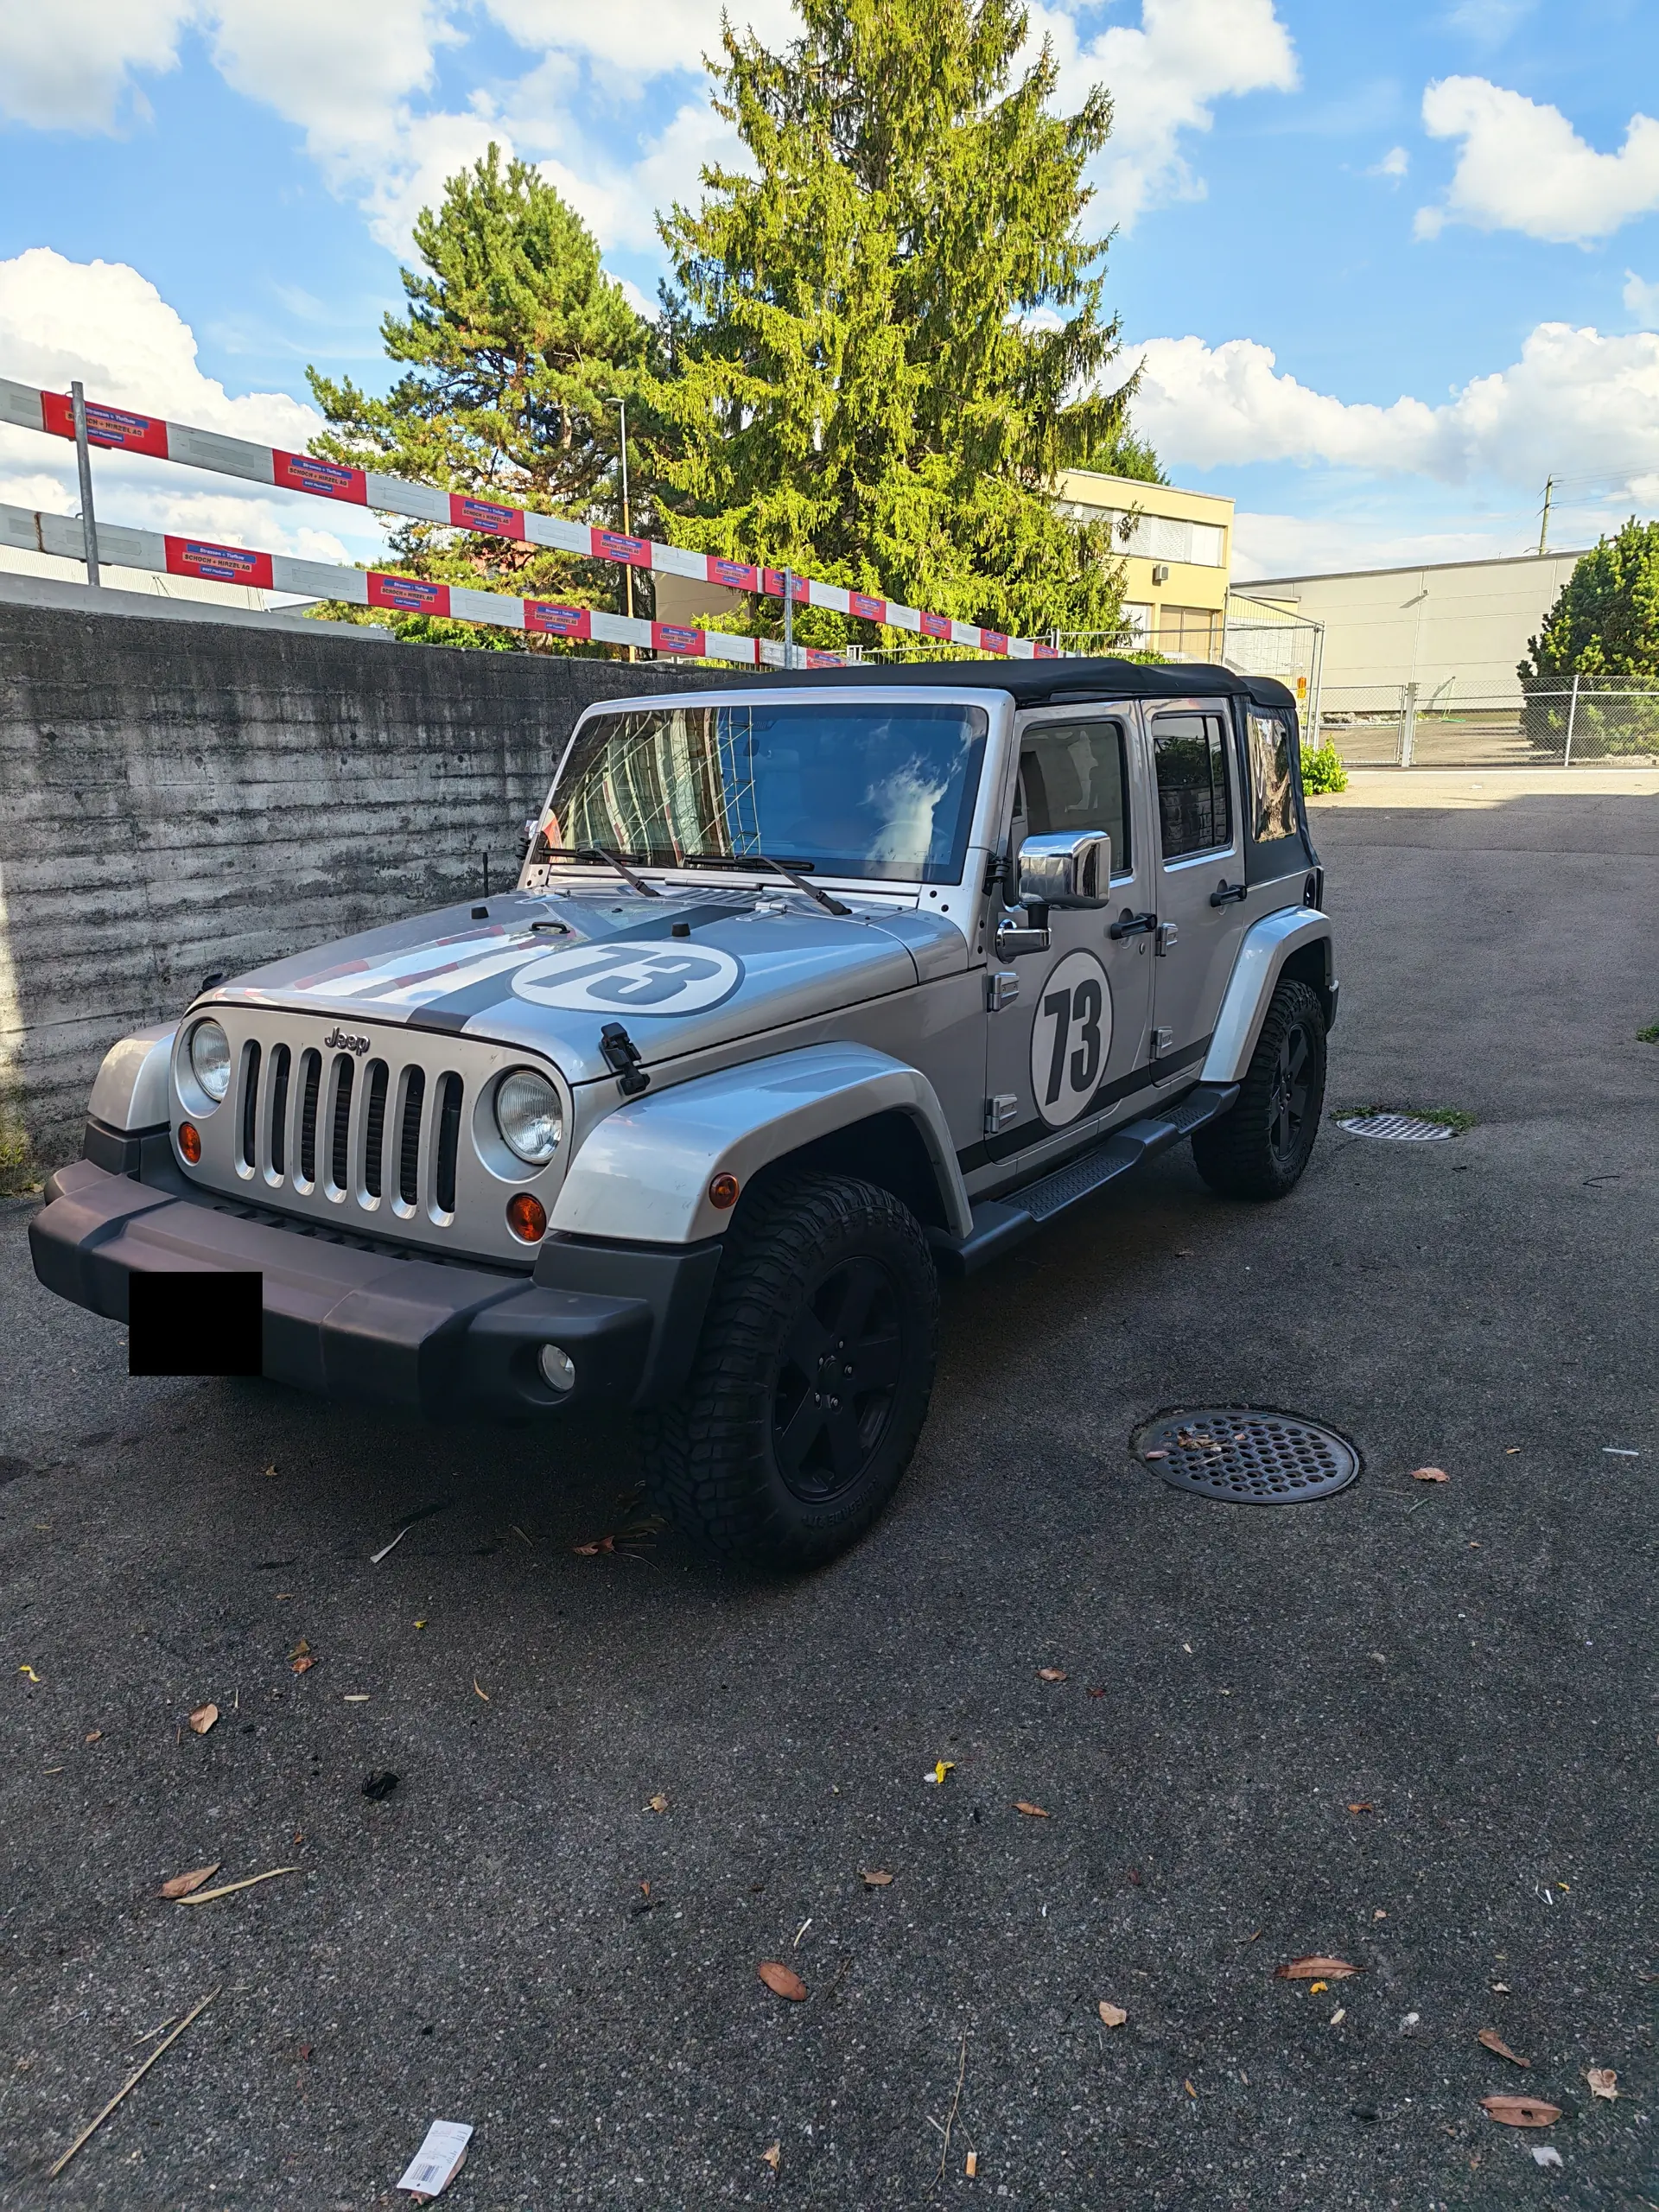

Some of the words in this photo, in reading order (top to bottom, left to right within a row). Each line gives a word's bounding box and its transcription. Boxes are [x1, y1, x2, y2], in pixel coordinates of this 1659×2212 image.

[67, 413, 98, 425] SCH
[105, 423, 130, 434] HIRZEL
[289, 467, 313, 477] SCHOCH
[319, 475, 338, 484] HIRZEL
[184, 554, 211, 563] SCHOCH
[218, 560, 240, 569] HIRZEL
[523, 946, 721, 1006] 73
[324, 1027, 371, 1057] Jeep
[1044, 979, 1102, 1107] 73
